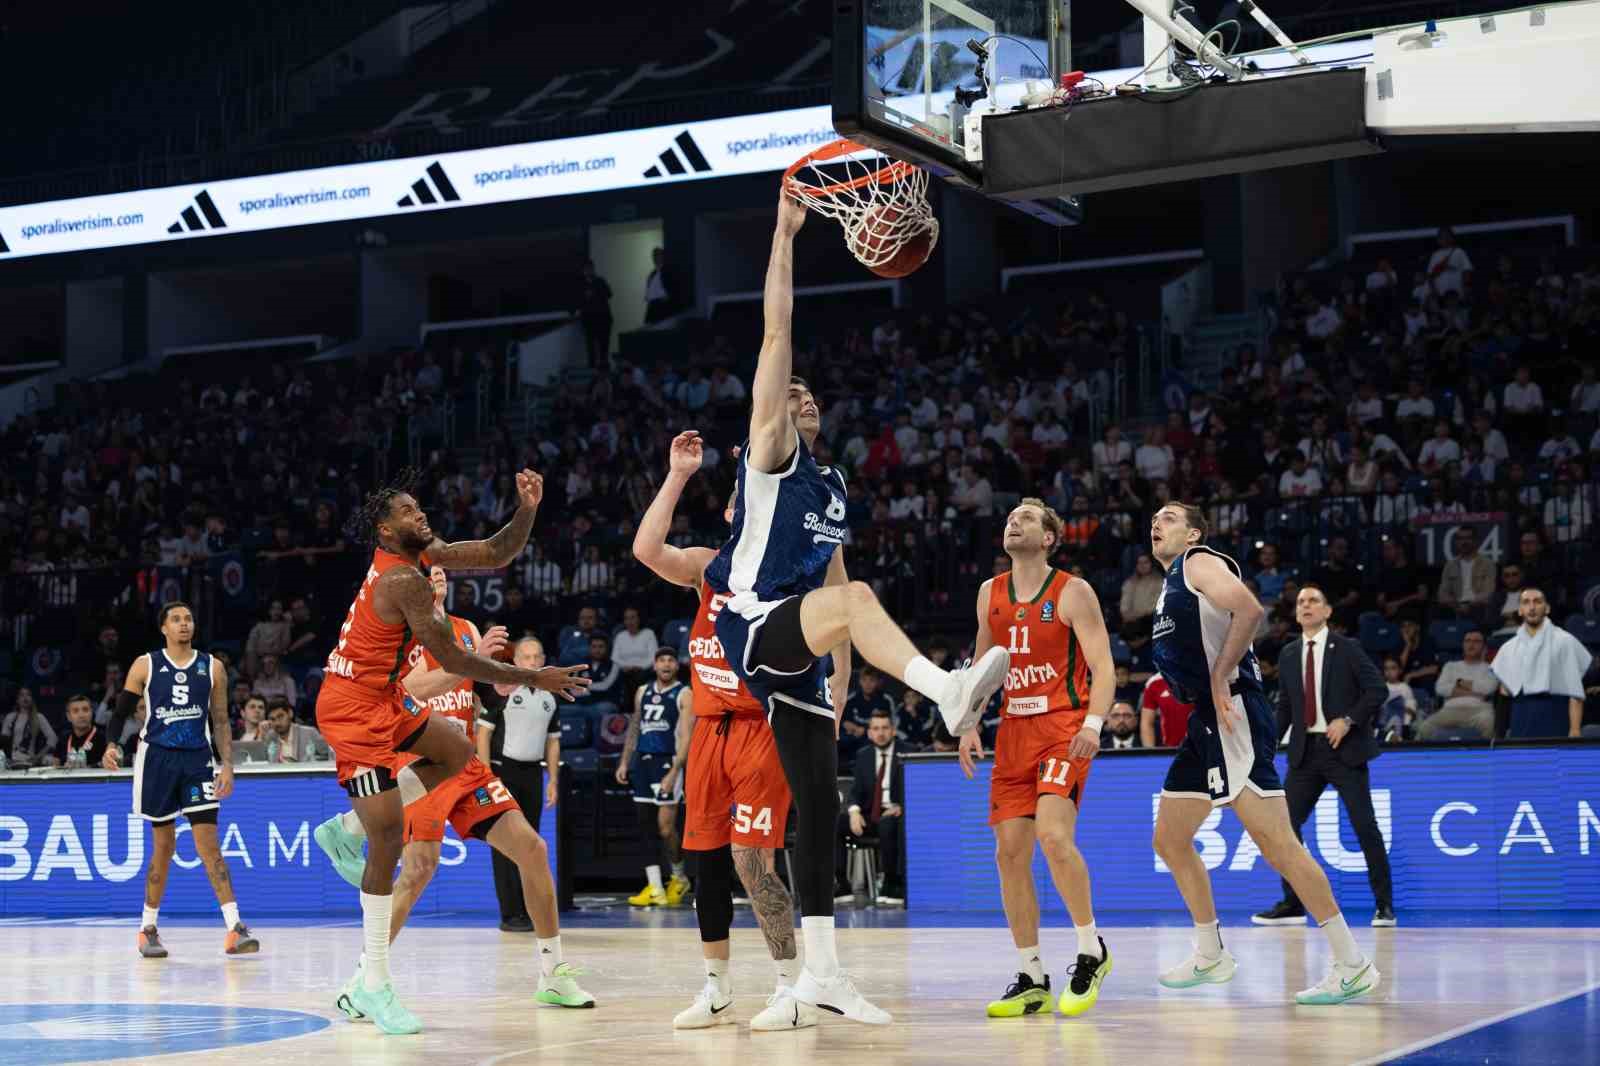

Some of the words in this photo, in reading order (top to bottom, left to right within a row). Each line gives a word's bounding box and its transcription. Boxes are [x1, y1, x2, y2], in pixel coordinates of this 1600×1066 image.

[474, 154, 617, 186] sporalisverisim.com
[239, 185, 372, 214] sporalisverisim.com
[21, 211, 145, 240] sporalisverisim.com
[825, 493, 846, 522] 8
[1008, 626, 1031, 654] 11
[171, 684, 190, 706] 5
[643, 704, 665, 721] 77
[1042, 757, 1071, 786] 11
[1207, 766, 1225, 795] 4
[202, 781, 217, 801] 5
[493, 777, 513, 804] 2
[734, 803, 773, 836] 54
[0, 812, 145, 883] BAU
